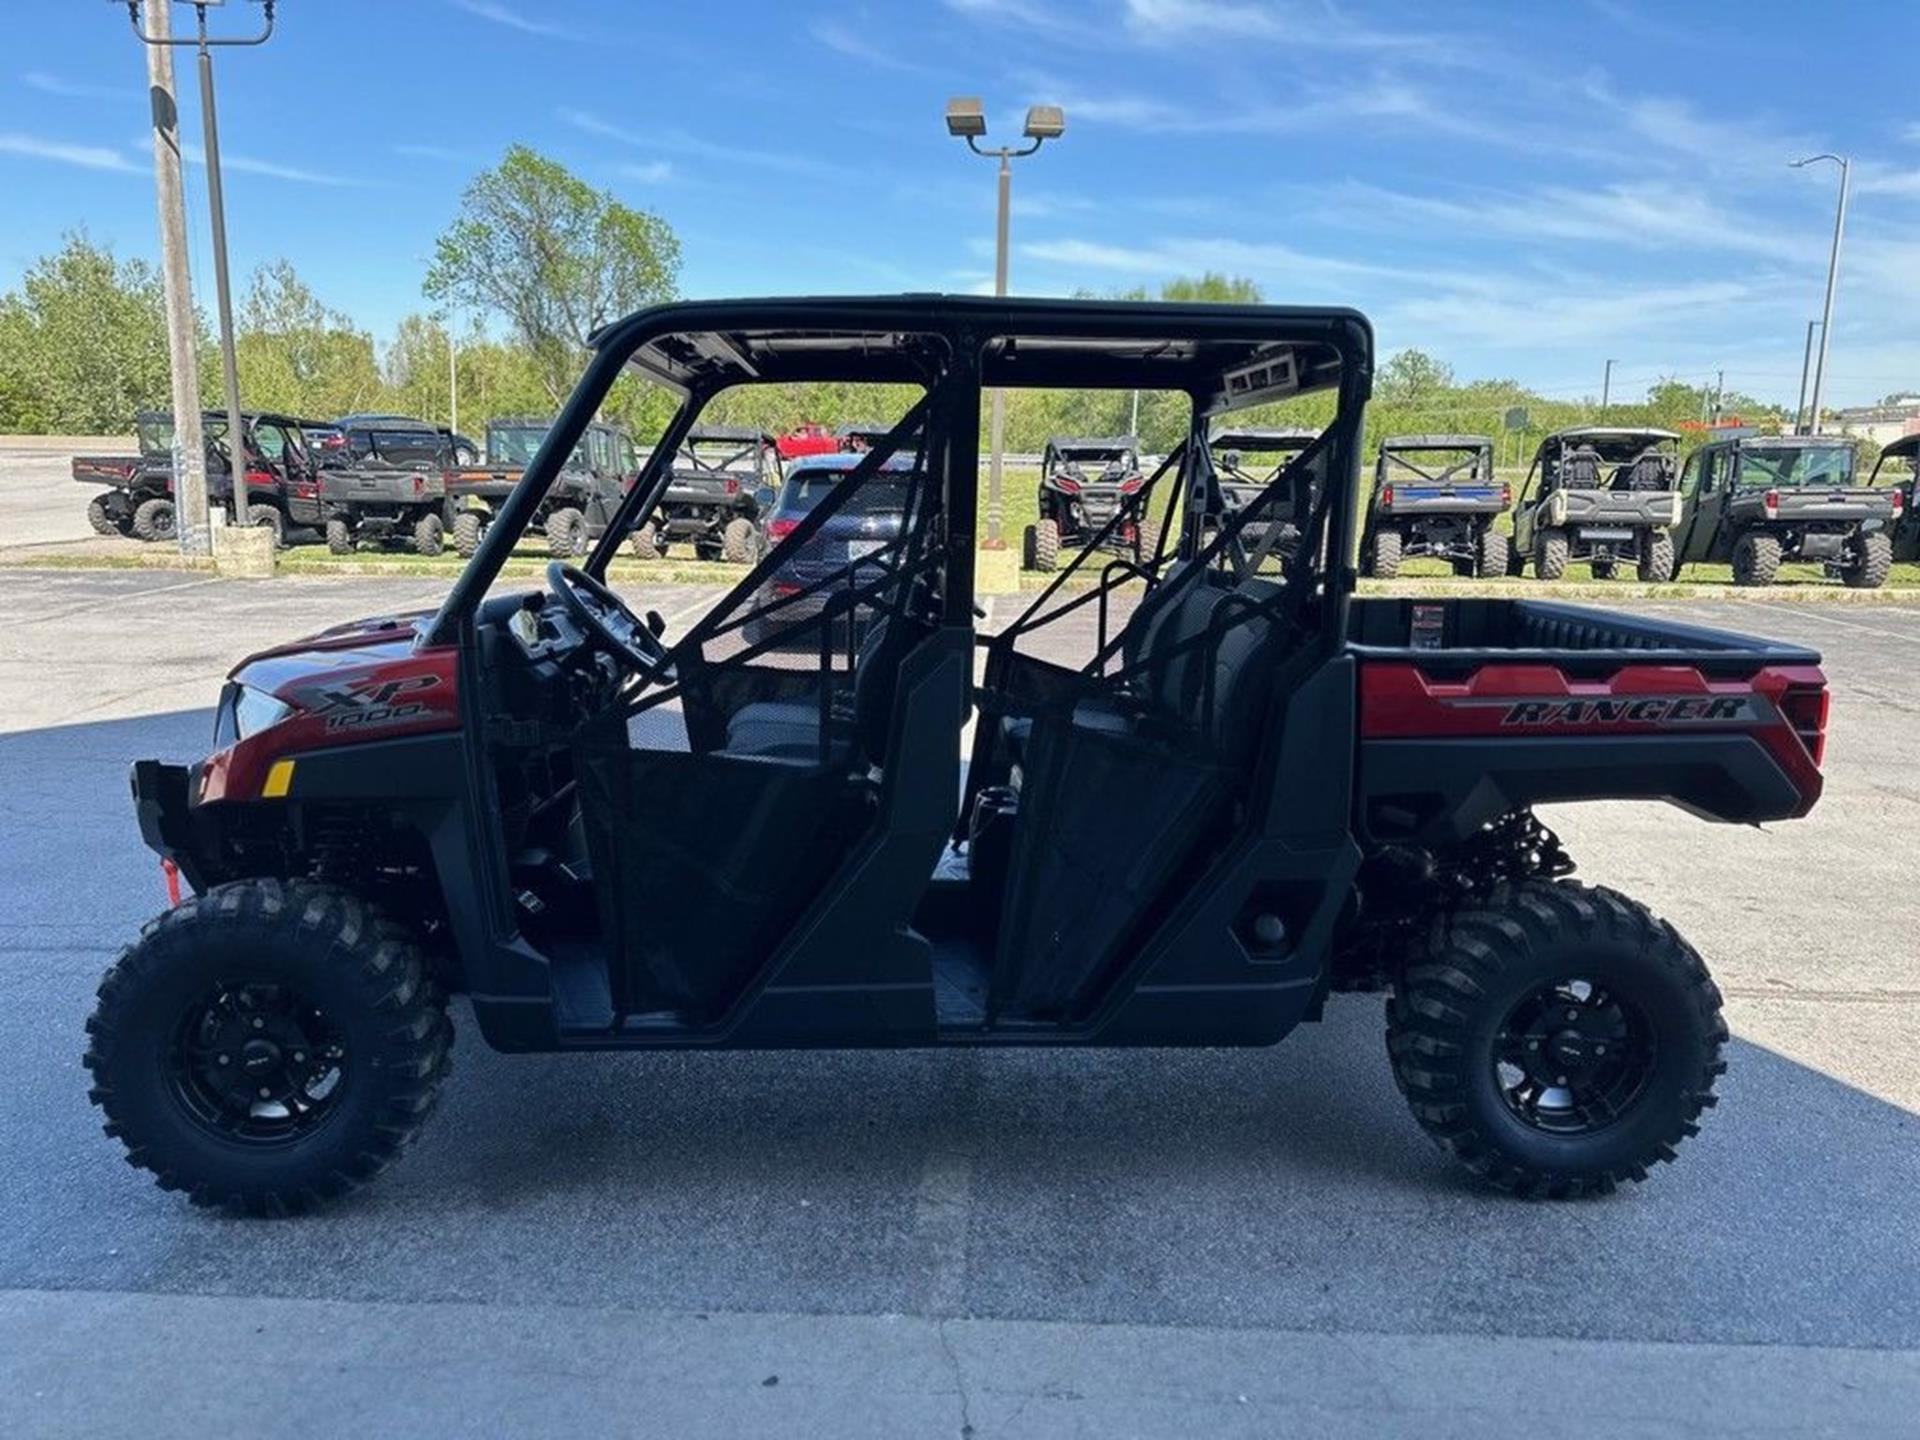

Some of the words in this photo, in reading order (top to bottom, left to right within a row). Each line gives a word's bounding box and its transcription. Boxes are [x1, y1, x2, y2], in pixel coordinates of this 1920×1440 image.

[313, 675, 442, 714] XP
[328, 704, 422, 728] 1000
[1503, 698, 1748, 725] RANGER
